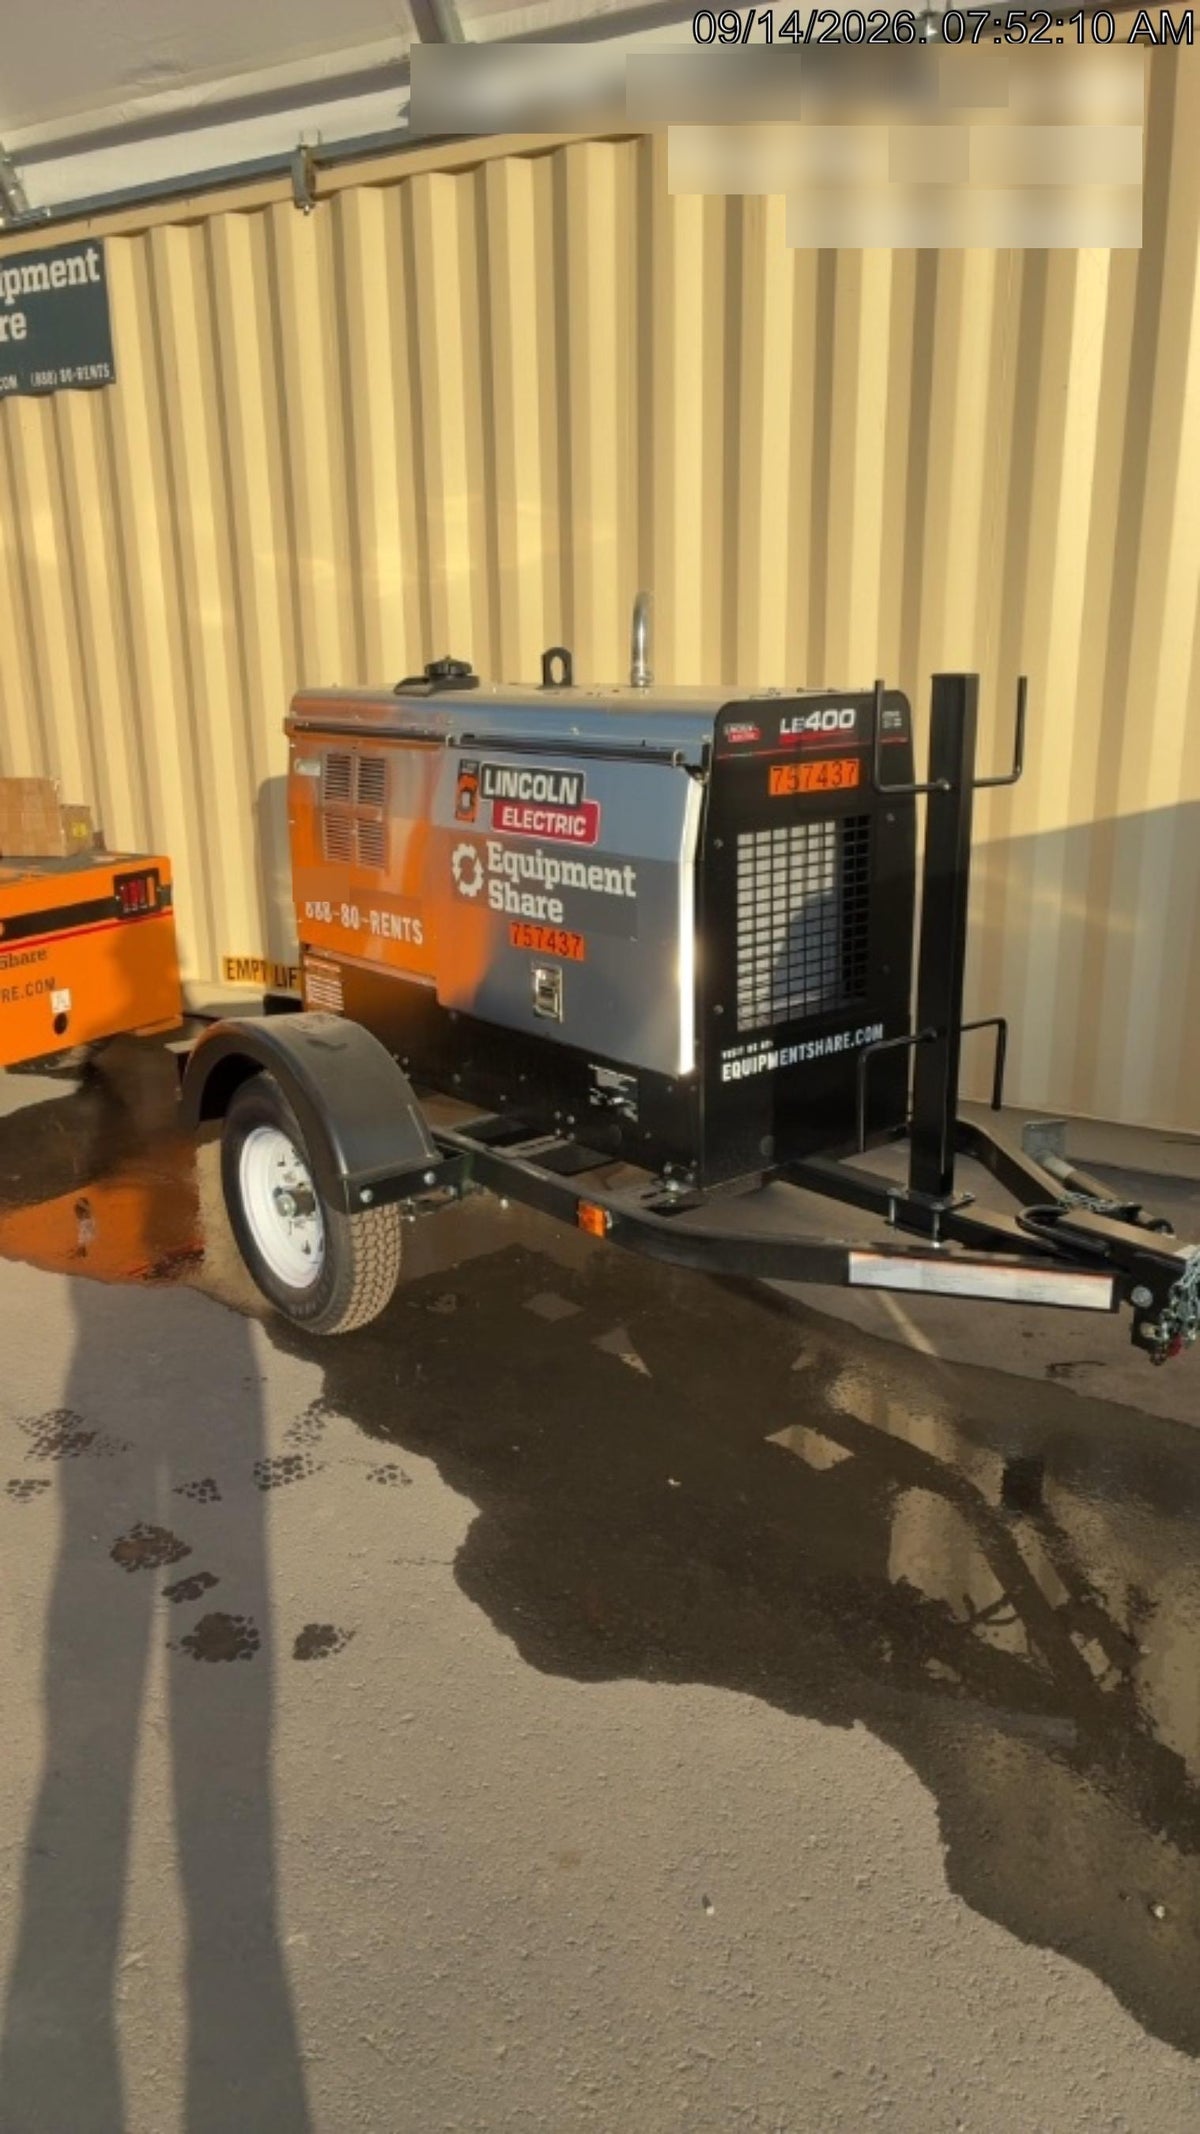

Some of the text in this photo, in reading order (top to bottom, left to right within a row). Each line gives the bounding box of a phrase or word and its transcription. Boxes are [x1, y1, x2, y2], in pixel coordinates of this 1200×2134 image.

[780, 708, 857, 734] LE400
[483, 769, 579, 805] LINCOLN
[773, 761, 857, 793] 757437
[502, 806, 587, 836] ELECTRIC
[486, 841, 637, 898] Equipment
[488, 879, 564, 923] Share
[511, 922, 582, 959] 757437
[226, 957, 268, 984] EMPT
[274, 963, 300, 989] LIF
[722, 1023, 884, 1082] EQUIPMENTSHARE.COM
